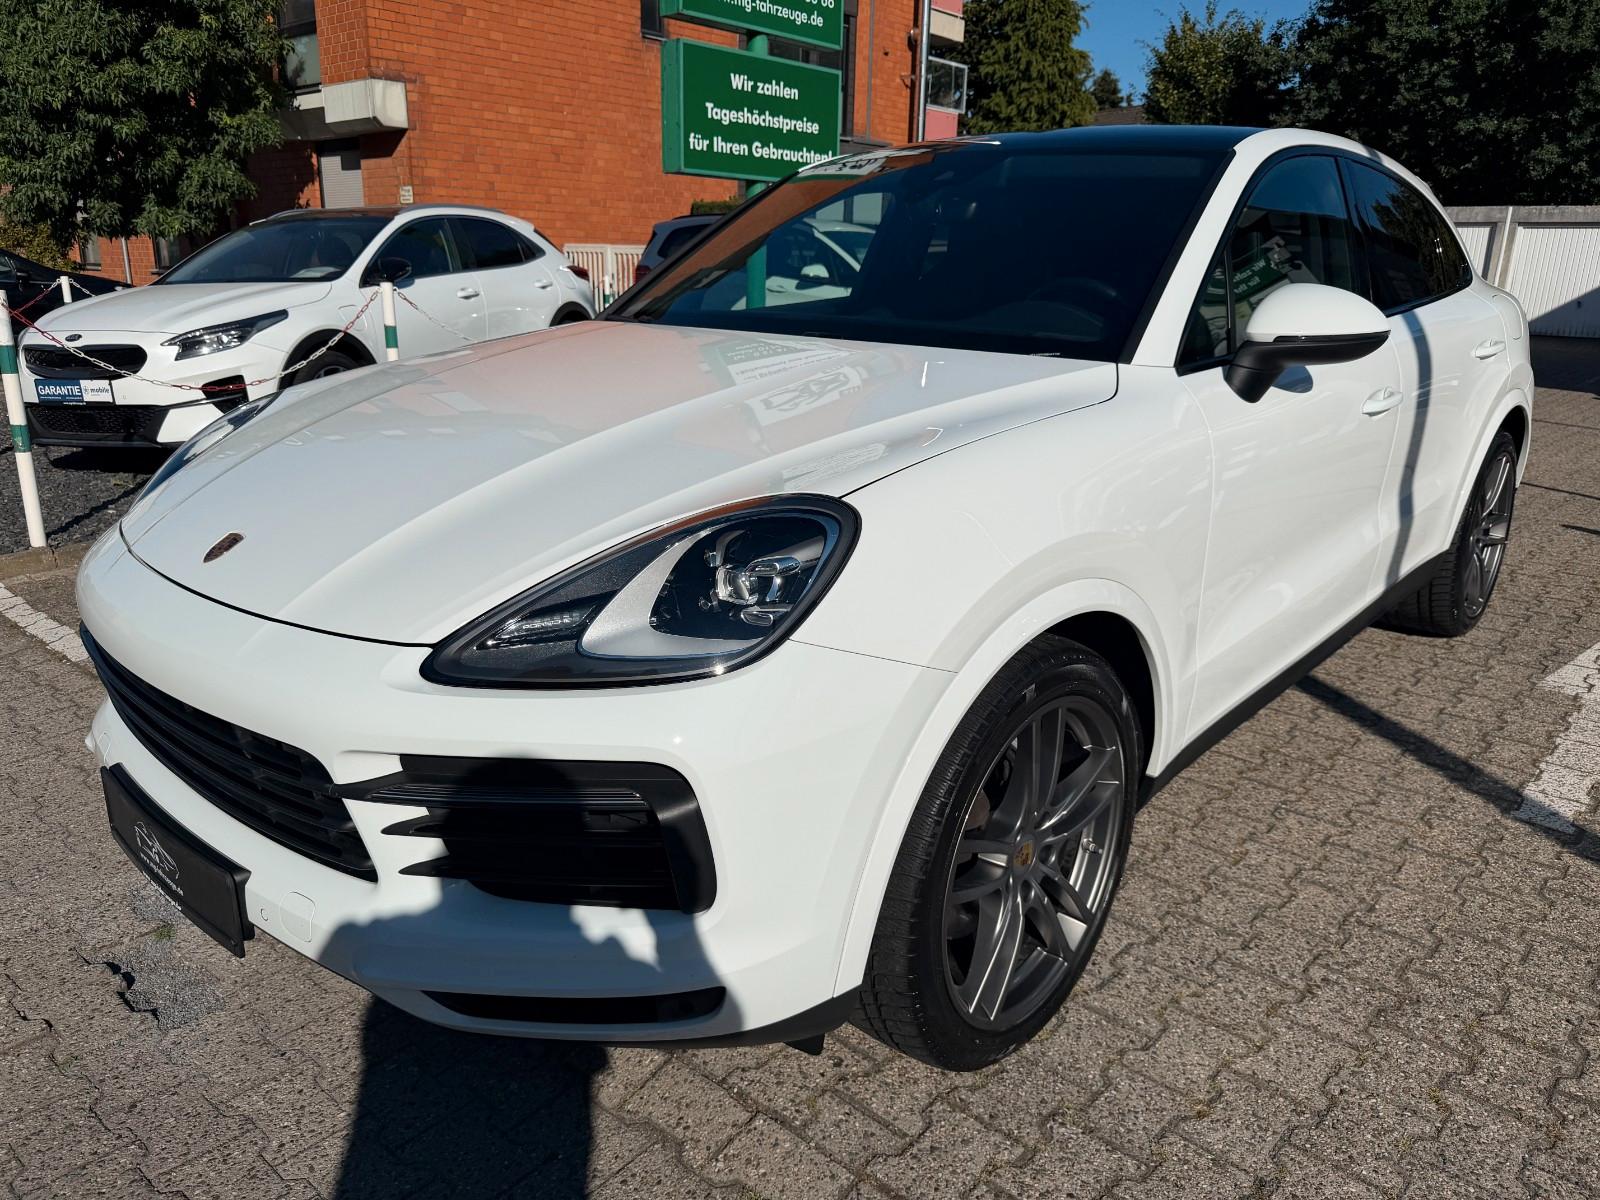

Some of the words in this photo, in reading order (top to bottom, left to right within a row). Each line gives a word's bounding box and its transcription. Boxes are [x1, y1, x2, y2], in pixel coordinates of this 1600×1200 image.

[723, 0, 824, 27] .mg-fahrzeuge.de
[730, 73, 754, 93] Wir
[757, 80, 799, 100] zahlen
[705, 102, 820, 134] Tageshöchstpreise
[689, 132, 710, 151] für
[713, 136, 749, 157] Ihren
[38, 385, 82, 396] GARANTIE
